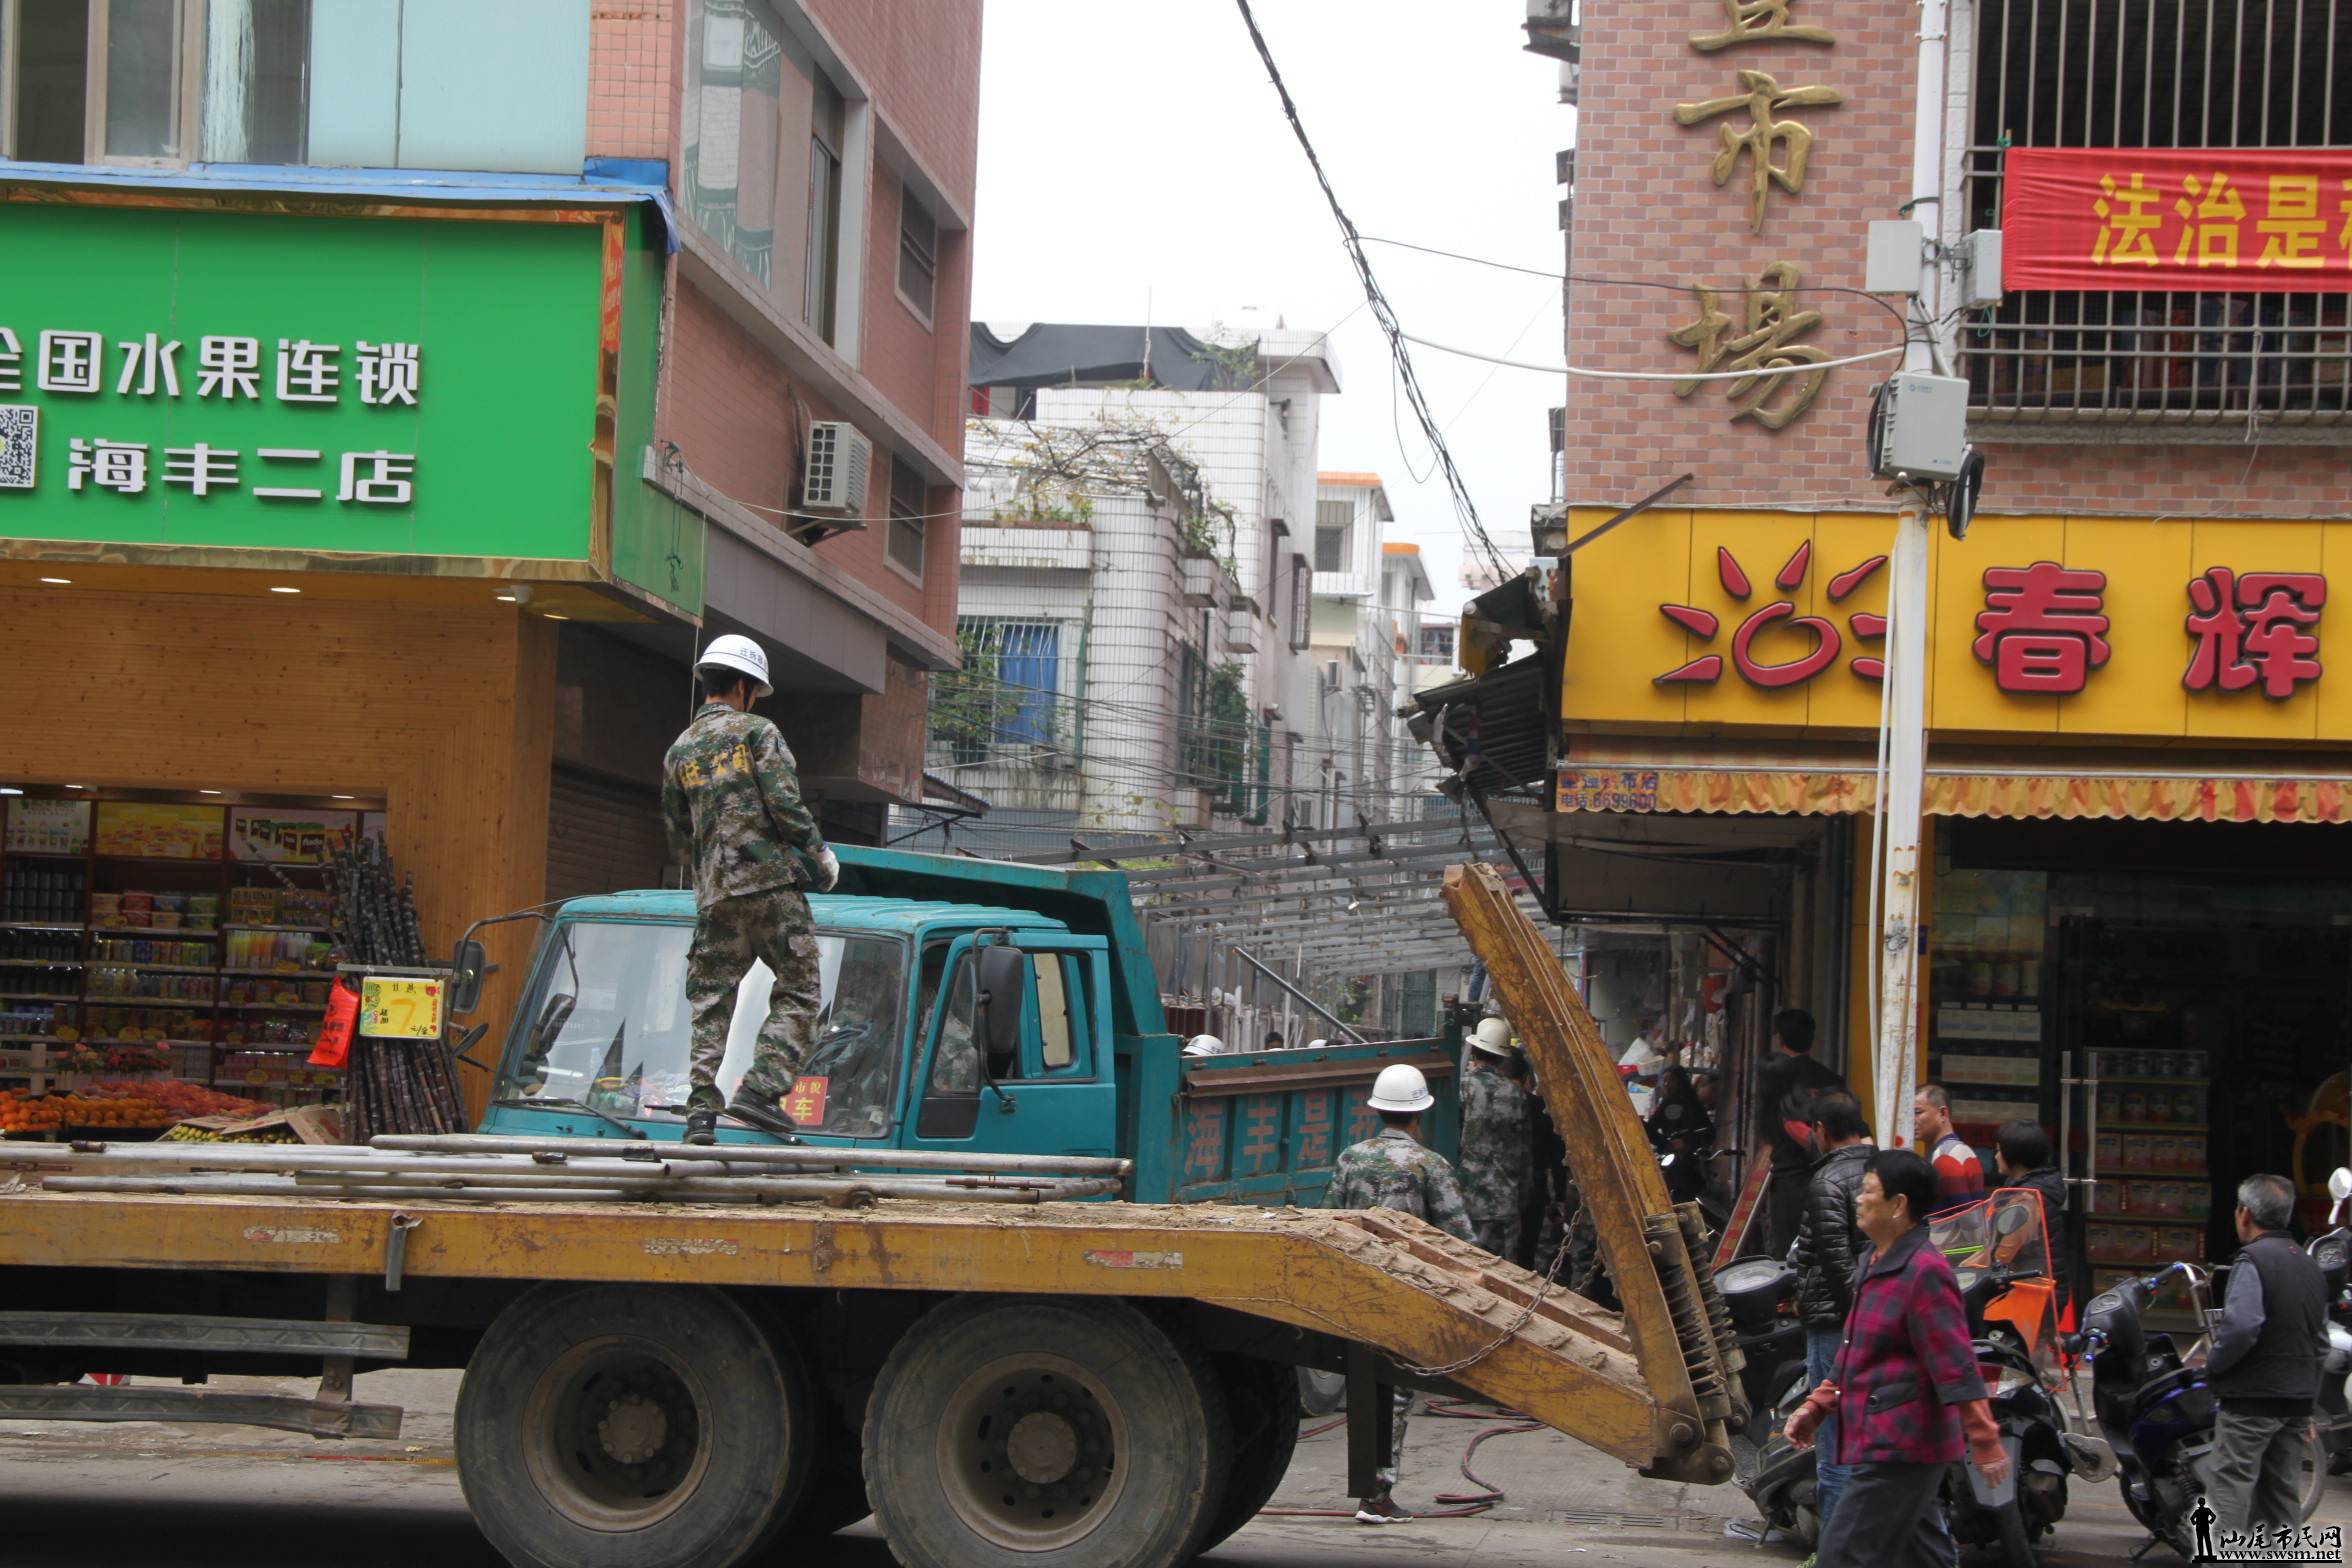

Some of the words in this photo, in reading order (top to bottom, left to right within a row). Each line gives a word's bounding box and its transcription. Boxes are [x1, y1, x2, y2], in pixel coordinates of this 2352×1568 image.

[2092, 173, 2352, 270] 法治是
[67, 438, 416, 504] 海丰二店
[1973, 561, 2328, 699] 春辉
